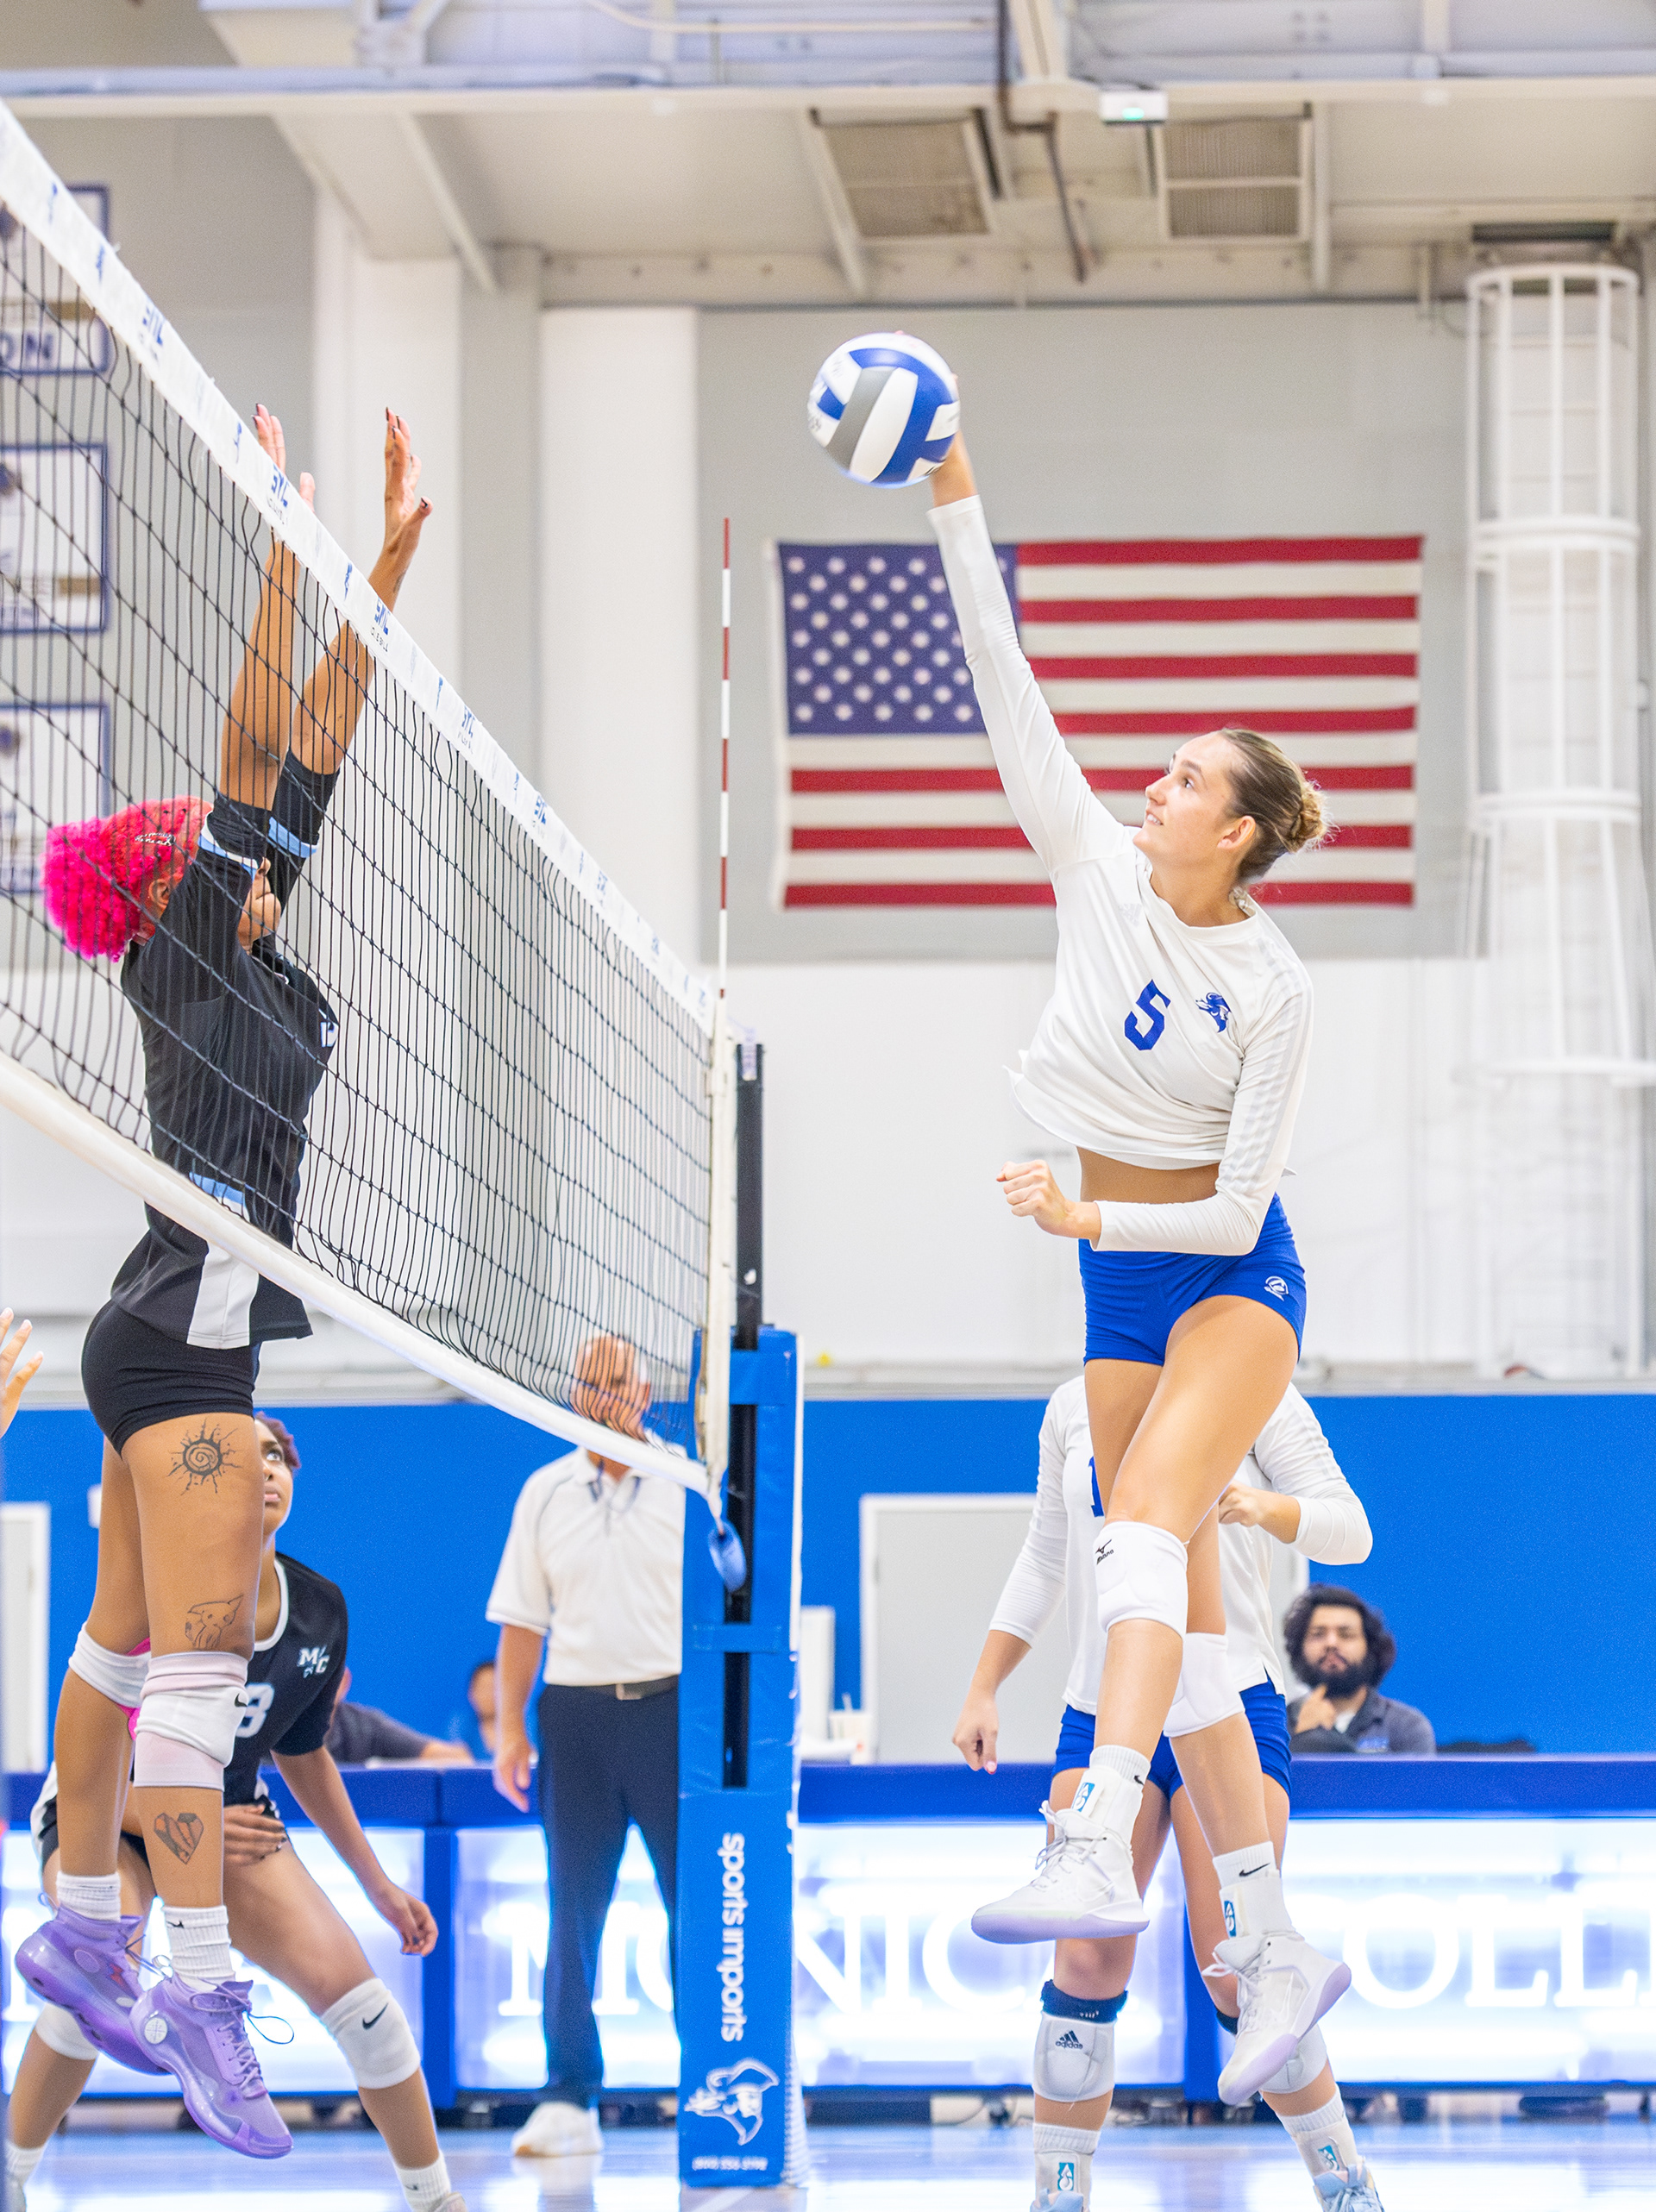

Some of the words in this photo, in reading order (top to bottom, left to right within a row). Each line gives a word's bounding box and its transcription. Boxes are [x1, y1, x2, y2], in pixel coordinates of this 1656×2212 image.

[1124, 979, 1171, 1051] 5
[717, 1832, 749, 1926] sports
[494, 1900, 1151, 2015] MNIC
[1285, 1895, 1656, 2010] OLL
[1055, 2040, 1083, 2050] adidas
